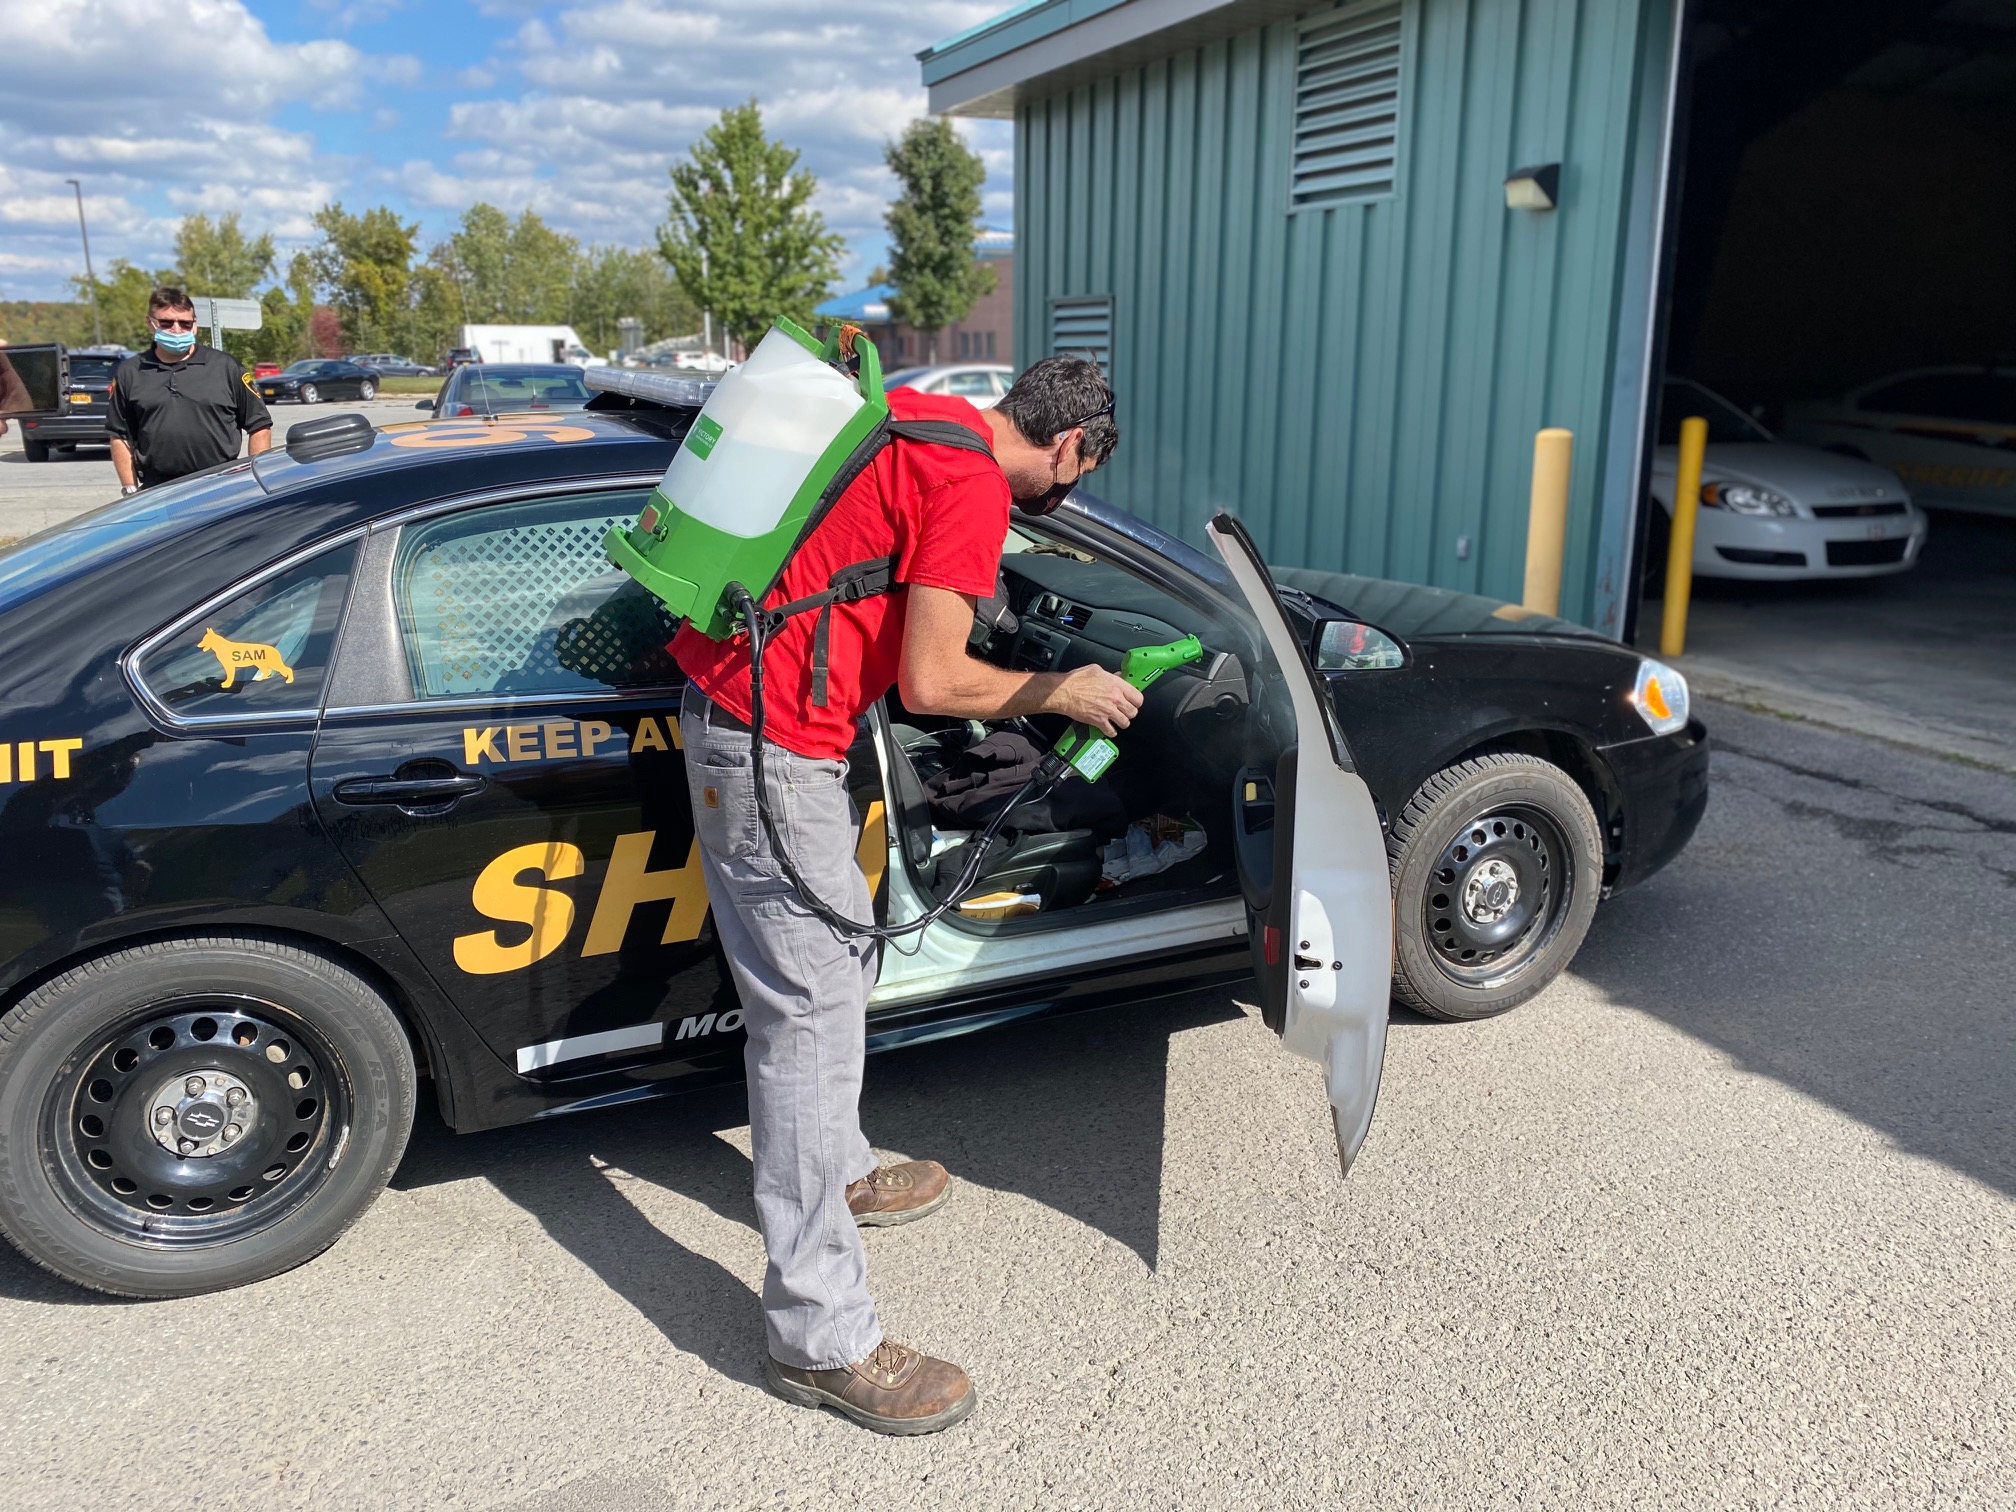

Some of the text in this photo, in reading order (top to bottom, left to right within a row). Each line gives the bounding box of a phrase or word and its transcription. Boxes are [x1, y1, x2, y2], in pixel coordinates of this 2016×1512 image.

[232, 649, 266, 662] SAM
[463, 720, 612, 765] KEEP
[453, 830, 712, 975] SH
[675, 1009, 745, 1041] MO
